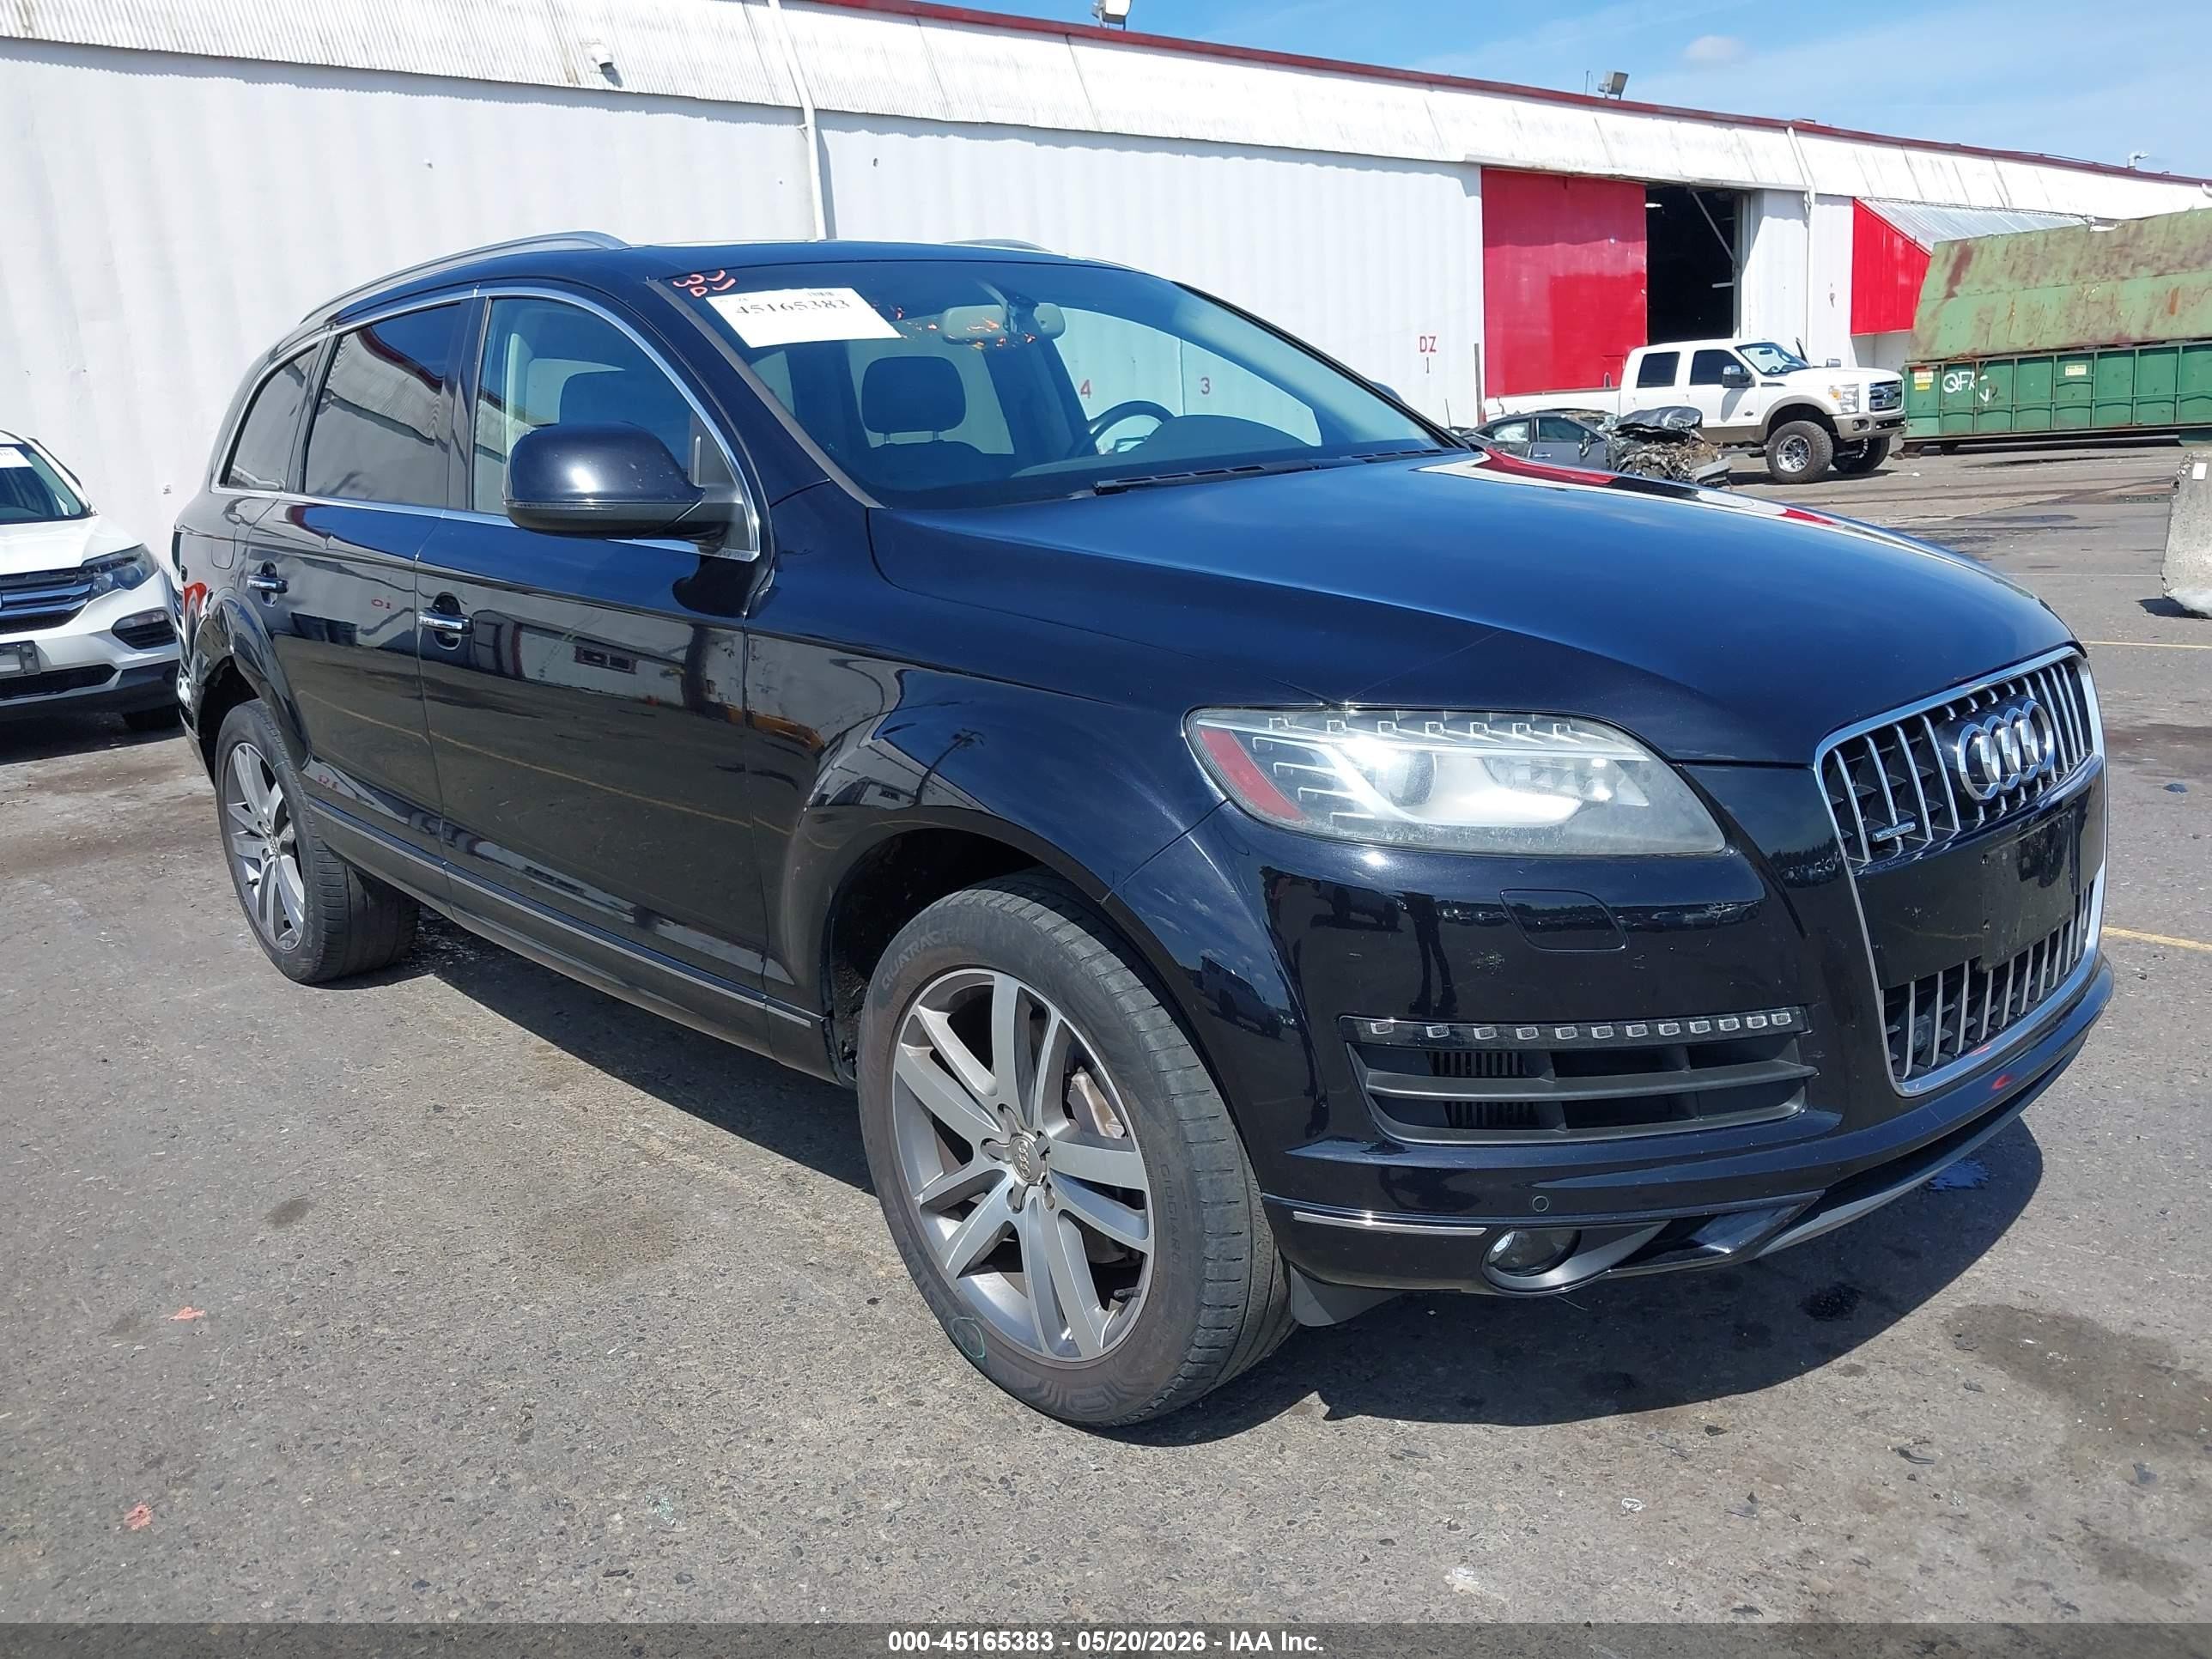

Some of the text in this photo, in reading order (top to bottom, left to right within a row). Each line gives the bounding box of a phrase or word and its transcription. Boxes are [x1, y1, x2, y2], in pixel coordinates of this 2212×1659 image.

[735, 298, 851, 315] 45165383
[1419, 335, 1437, 353] DZ
[1079, 377, 1211, 399] 4 3
